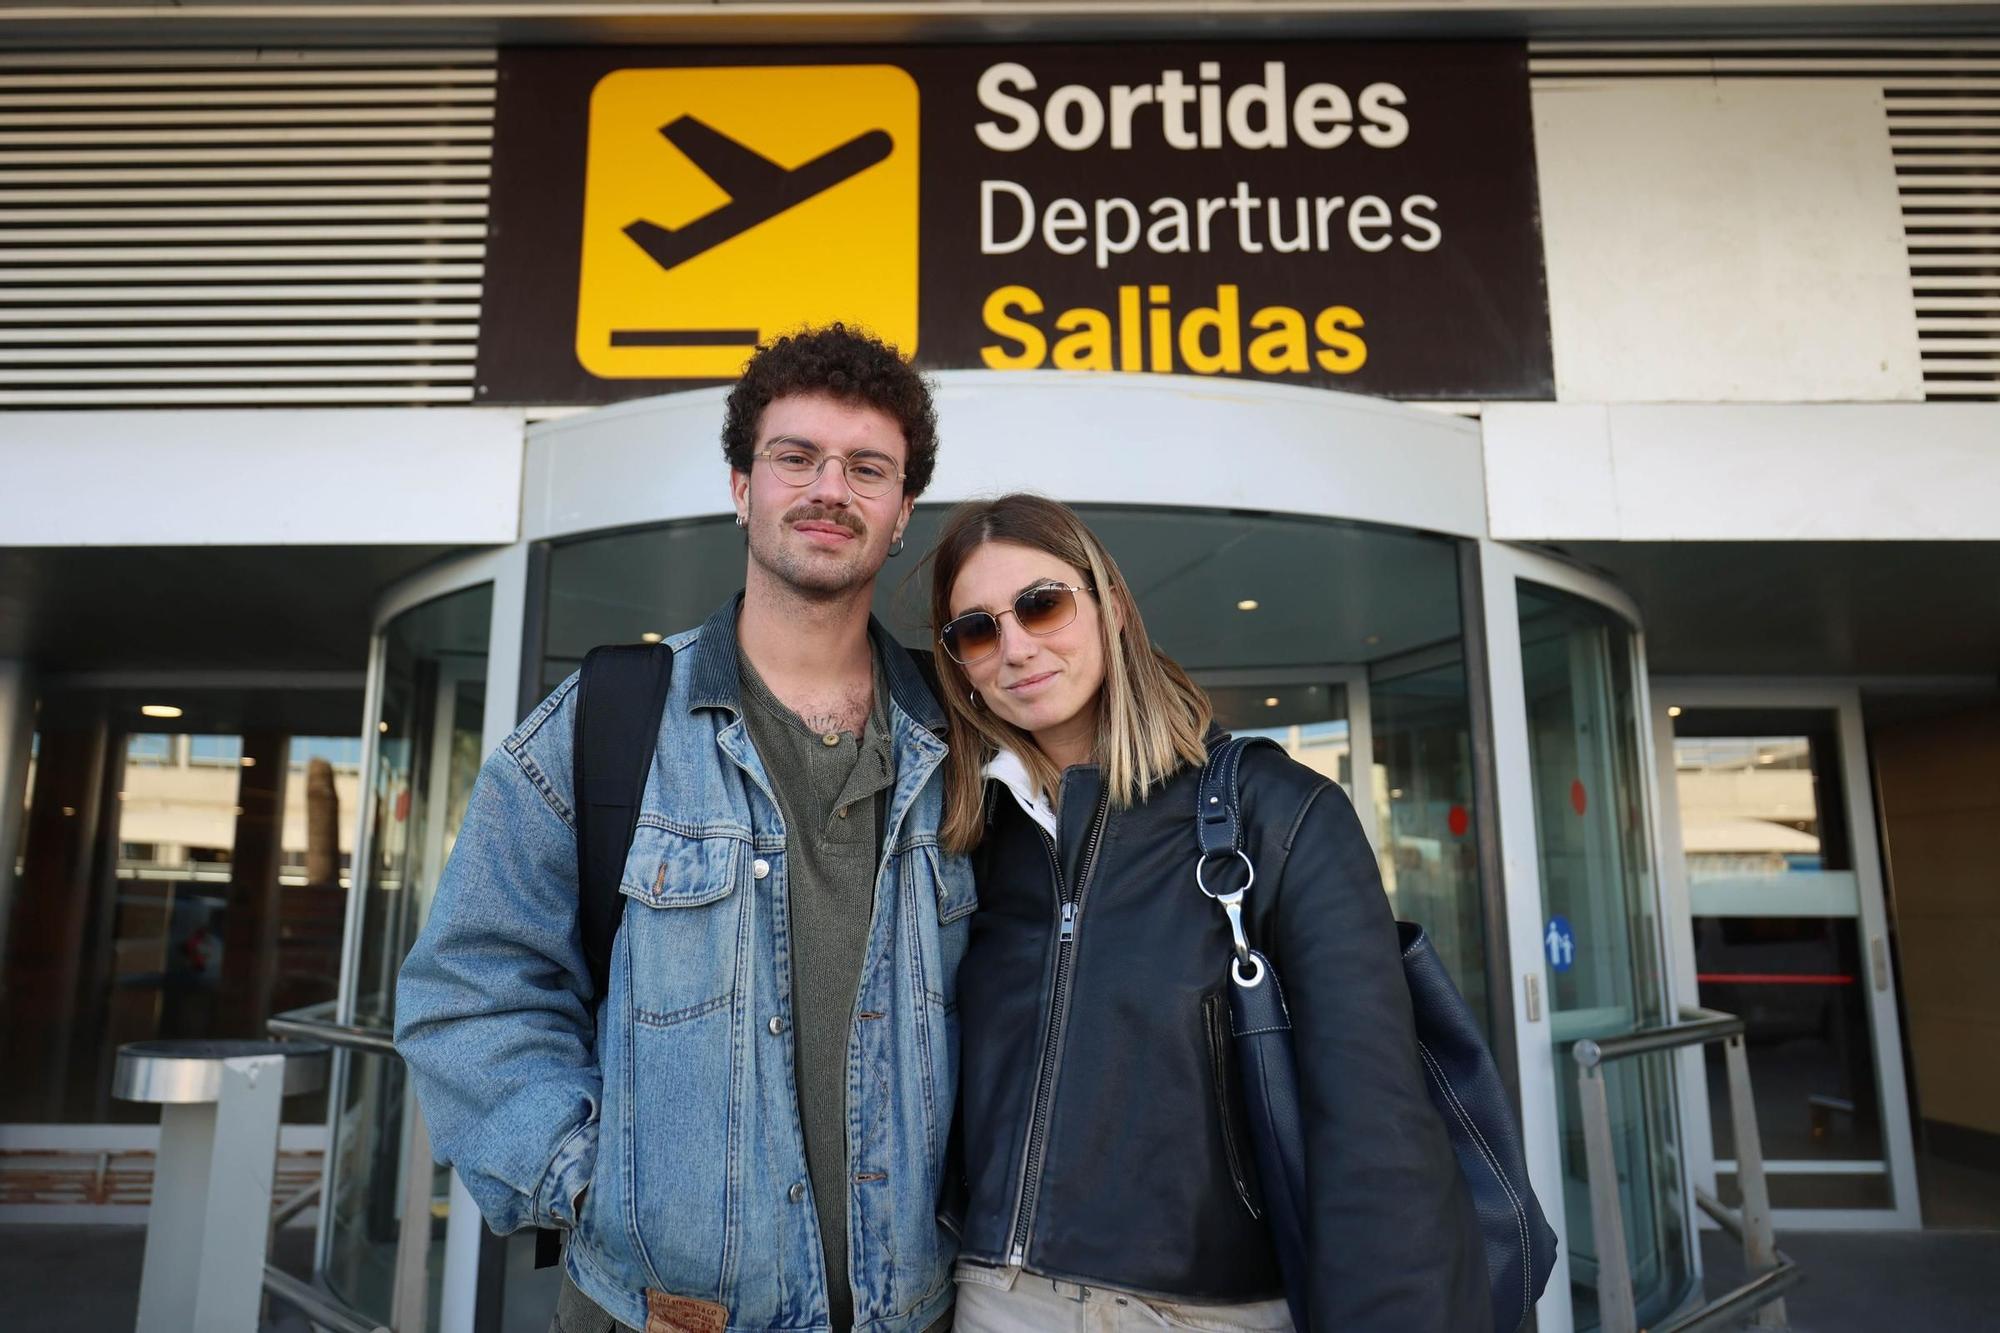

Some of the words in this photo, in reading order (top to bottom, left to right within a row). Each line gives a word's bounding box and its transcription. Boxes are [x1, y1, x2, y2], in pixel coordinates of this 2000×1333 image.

[974, 61, 1410, 151] Sortides
[980, 179, 1442, 269] Departures
[980, 284, 1368, 374] Salidas
